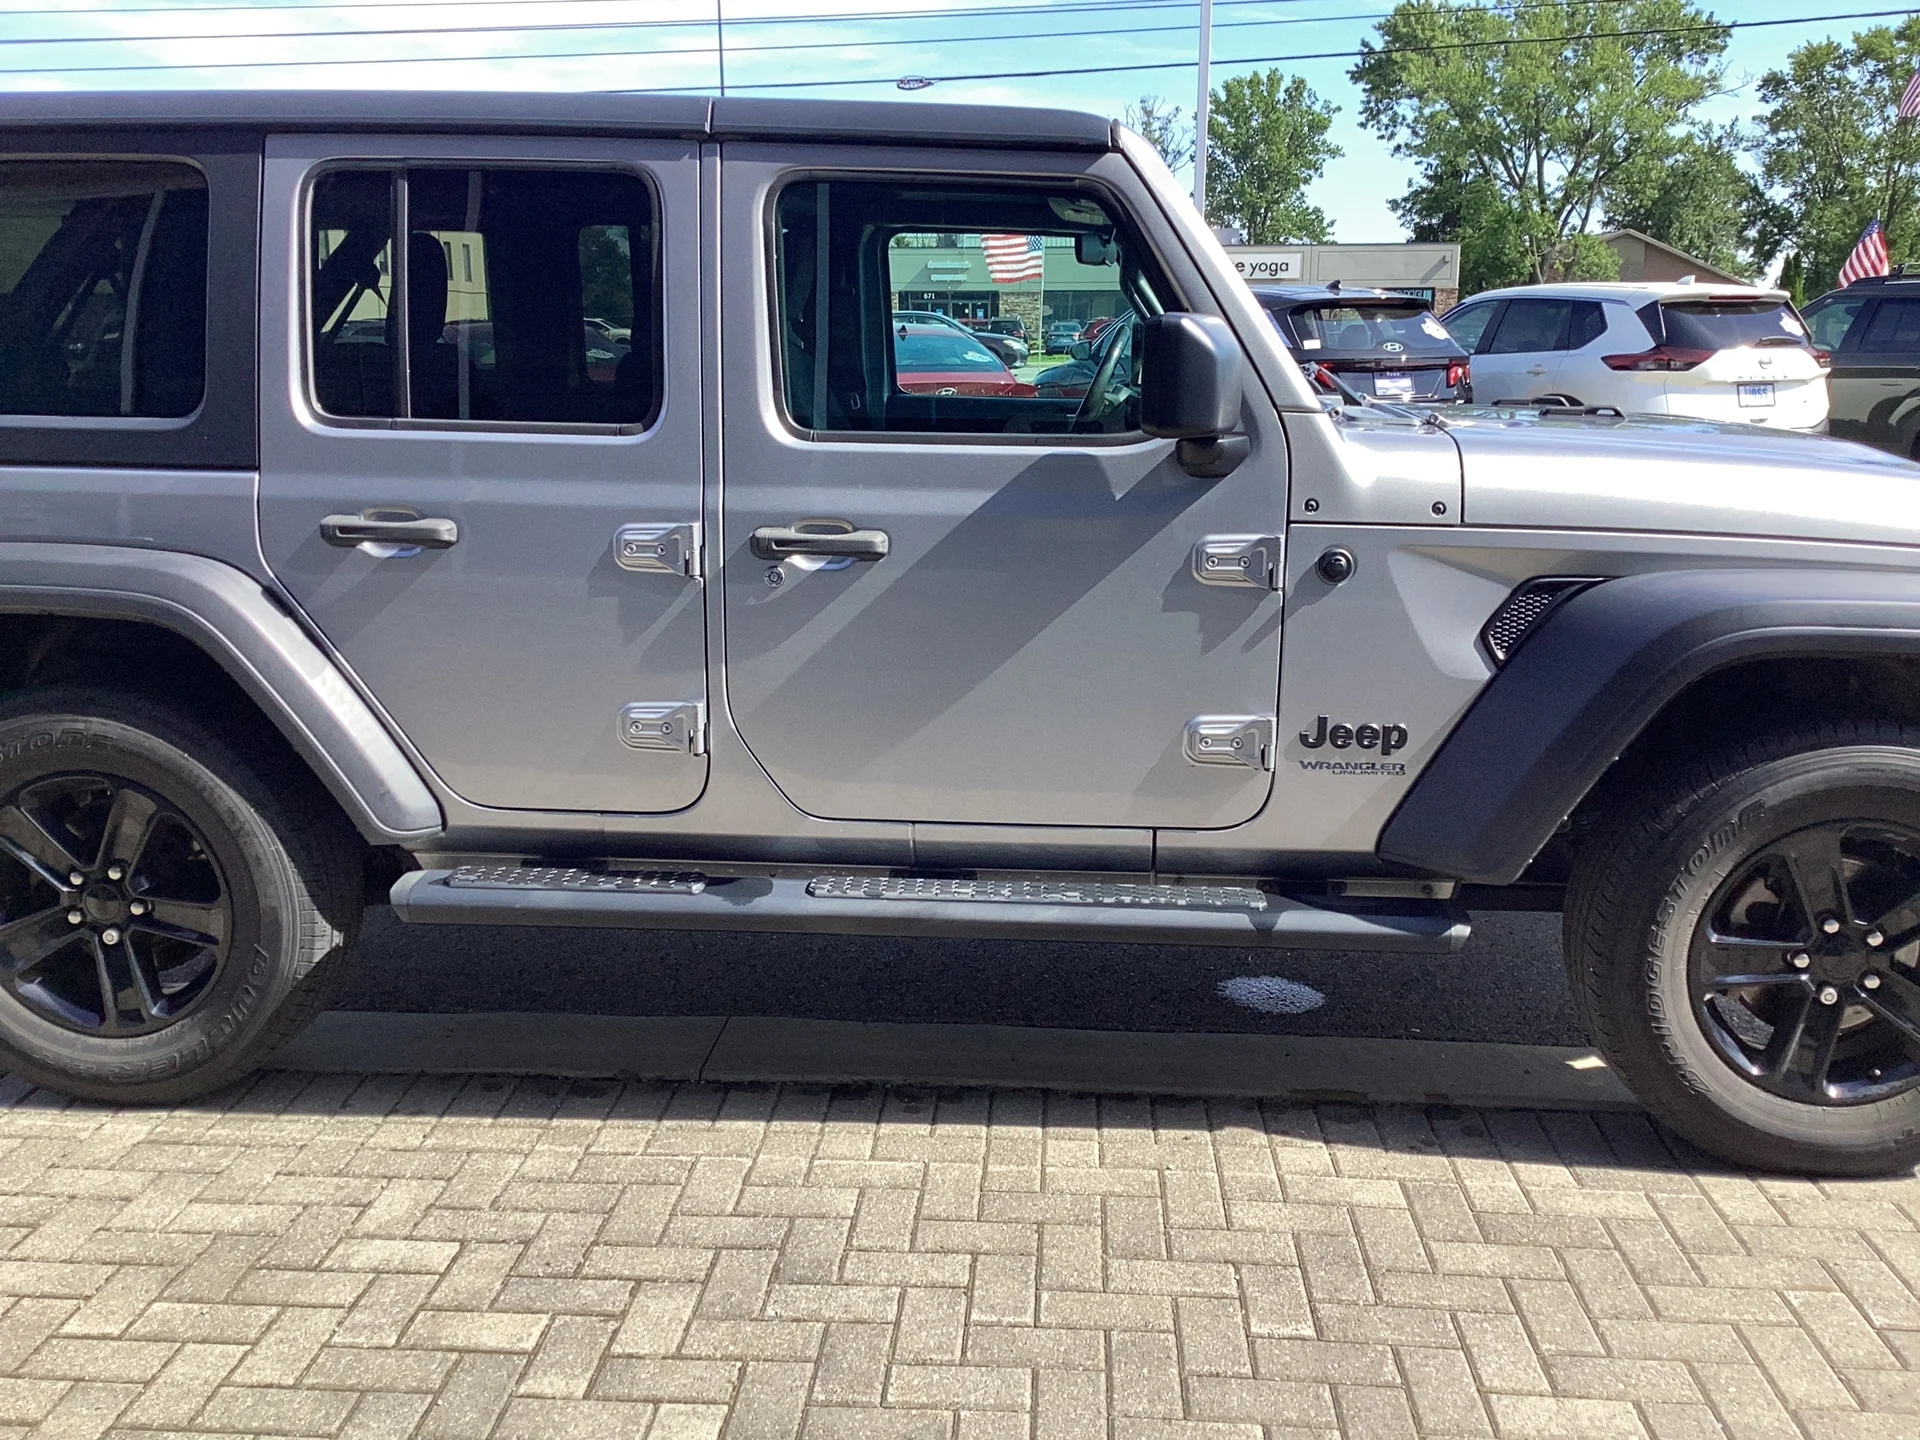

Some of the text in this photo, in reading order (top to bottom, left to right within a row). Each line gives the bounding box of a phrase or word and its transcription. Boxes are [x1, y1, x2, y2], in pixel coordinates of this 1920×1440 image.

[1250, 261, 1289, 277] yoga
[923, 292, 935, 300] 671
[0, 727, 117, 762] TONE
[1299, 714, 1408, 756] Jeep
[1299, 760, 1406, 772] WRANGLER
[1645, 798, 1767, 1095] BRIDGESTONE
